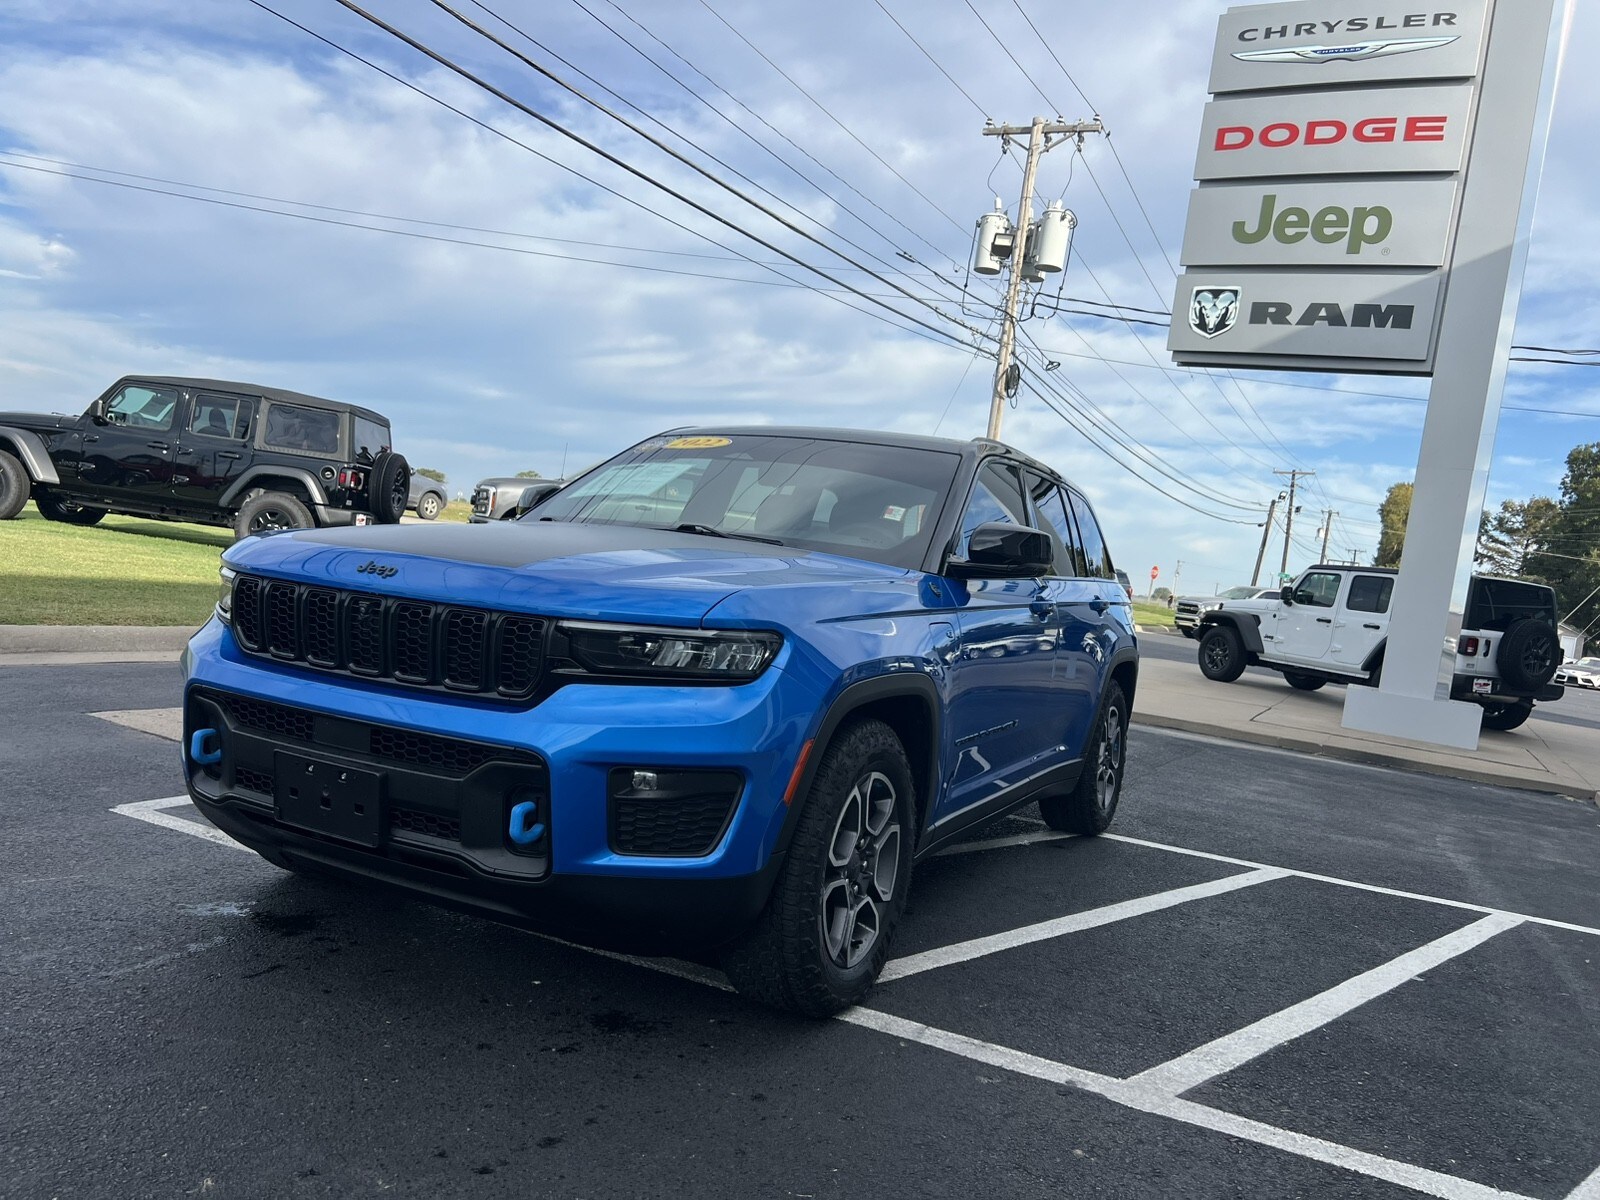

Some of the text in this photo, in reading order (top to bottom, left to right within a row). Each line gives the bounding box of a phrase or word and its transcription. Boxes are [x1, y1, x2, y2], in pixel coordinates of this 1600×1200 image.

[1238, 12, 1458, 41] CHRYSLER
[1214, 116, 1448, 151] DODGE
[1231, 194, 1393, 255] Jeep
[1248, 301, 1415, 330] RAM
[357, 560, 399, 579] Jeep
